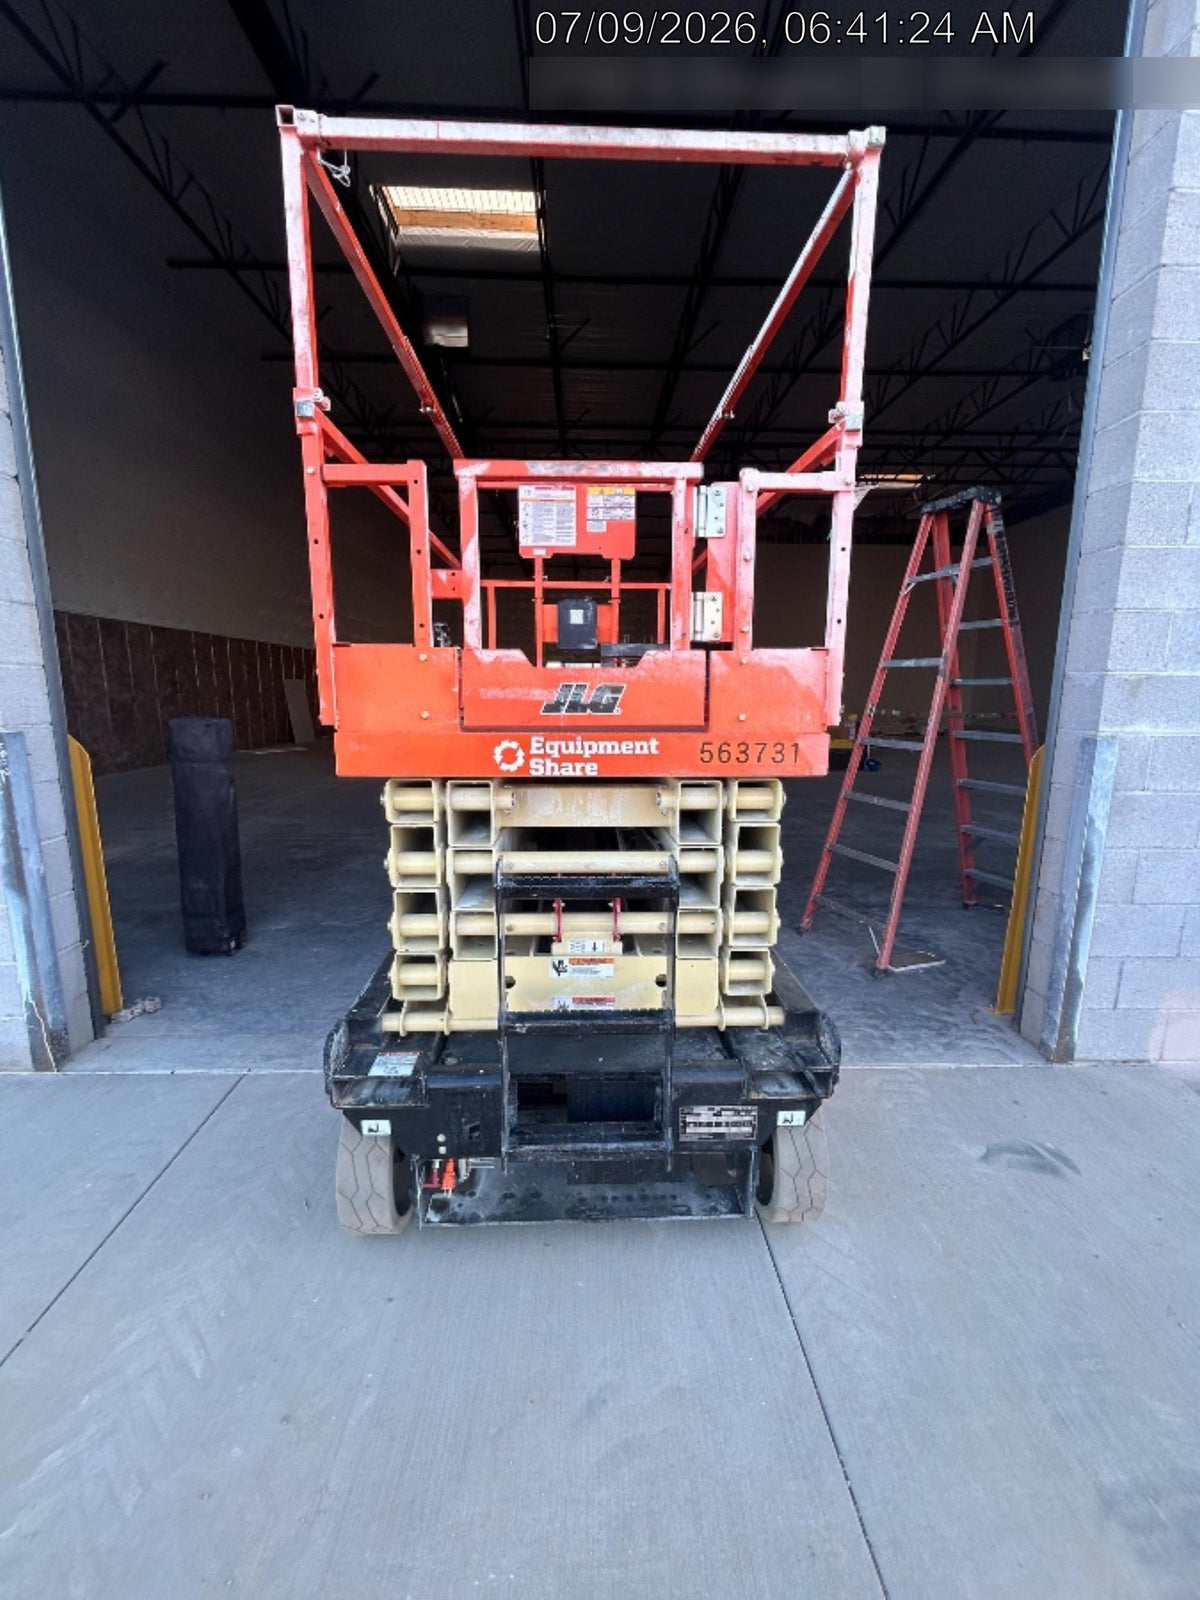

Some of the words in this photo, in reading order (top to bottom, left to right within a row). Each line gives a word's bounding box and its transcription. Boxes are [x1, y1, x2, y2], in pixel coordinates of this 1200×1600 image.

[541, 682, 626, 715] JLG
[529, 736, 659, 759] Equipment
[699, 742, 800, 764] 563731
[529, 760, 598, 776] Share
